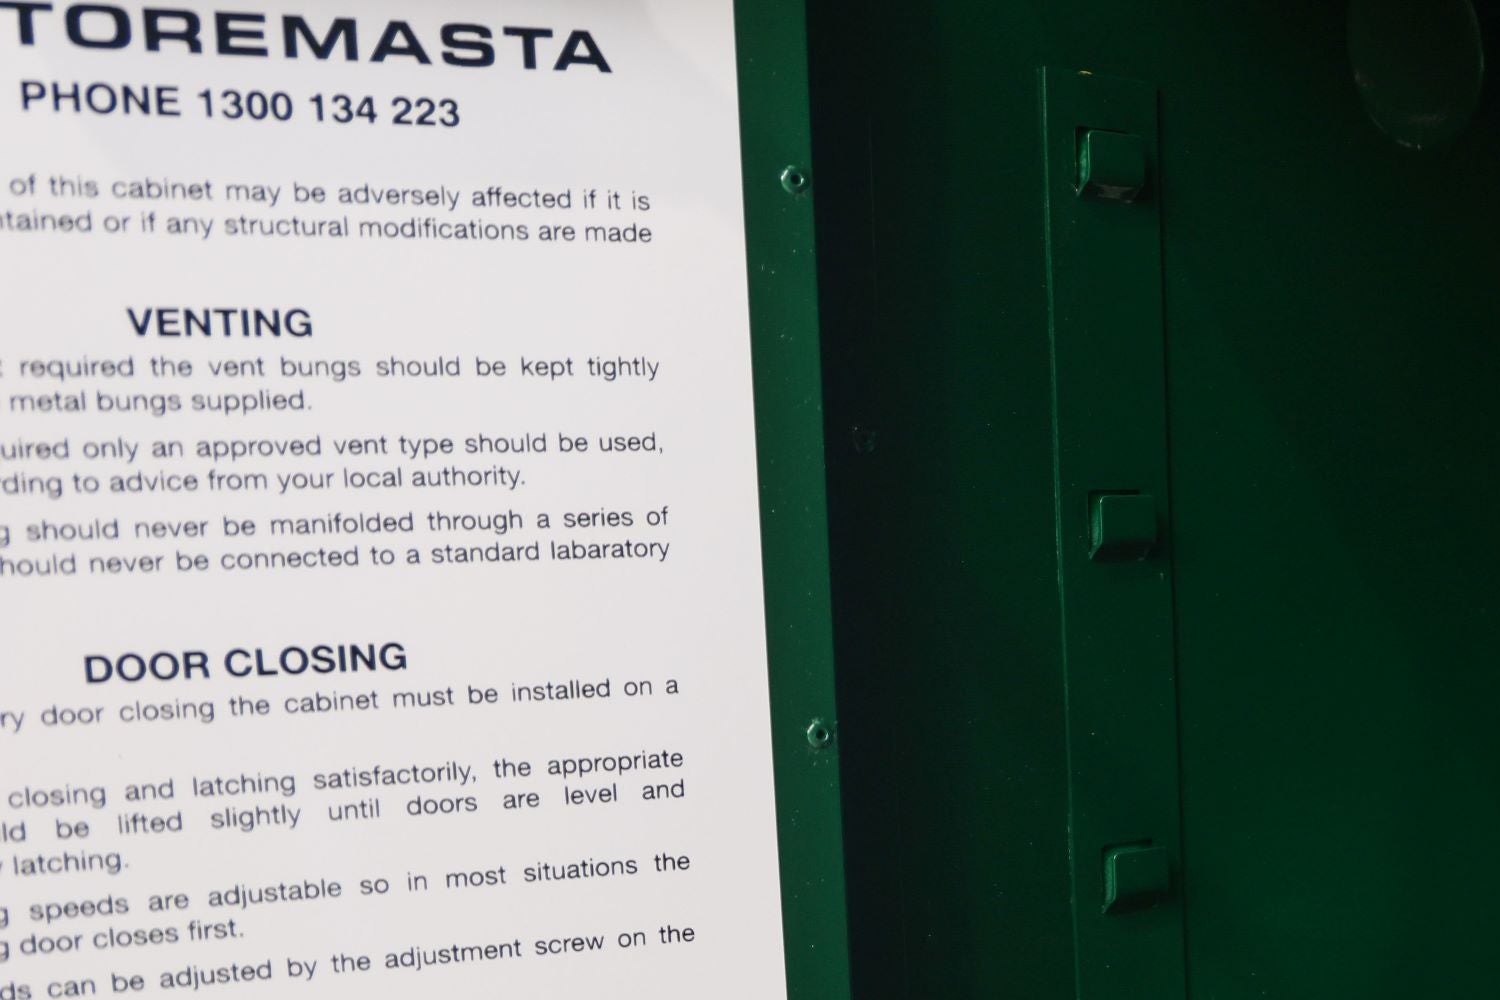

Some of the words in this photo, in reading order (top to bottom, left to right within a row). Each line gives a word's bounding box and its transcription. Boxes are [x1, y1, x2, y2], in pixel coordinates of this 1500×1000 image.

[0, 1, 612, 73] TOREMASTA
[20, 78, 181, 118] PHONE
[197, 87, 294, 123] 1300
[309, 92, 378, 125] 134
[391, 95, 460, 129] 223
[9, 172, 36, 196] of
[48, 175, 99, 199] this
[112, 177, 212, 201] cabinet
[226, 183, 280, 208] may
[293, 181, 326, 204] be
[338, 183, 460, 212] adversely
[472, 185, 571, 210] affected
[584, 188, 596, 209] if
[608, 189, 621, 211] it
[632, 190, 650, 212] is
[103, 215, 131, 234] or
[141, 211, 156, 233] if
[167, 216, 213, 241] any
[224, 214, 349, 238] structural
[359, 216, 529, 242] modifications
[539, 224, 576, 242] are
[585, 222, 652, 244] made
[125, 306, 312, 339] VENTING
[20, 355, 134, 383] required
[150, 355, 192, 378] the
[208, 356, 265, 378] vent
[280, 355, 361, 383] bungs
[376, 355, 460, 378] should
[476, 356, 506, 377] be
[521, 356, 574, 382] kept
[587, 355, 659, 383] tightly
[10, 390, 86, 413] metal
[96, 389, 182, 418] bungs
[191, 389, 312, 416] supplied.
[83, 437, 138, 464] only
[152, 440, 183, 459] an
[196, 434, 321, 463] approved
[333, 435, 388, 457] vent
[398, 434, 454, 460] type
[465, 431, 547, 455] should
[558, 431, 588, 453] be
[599, 431, 662, 454] used,
[0, 471, 63, 500] ding
[72, 473, 100, 494] to
[110, 470, 198, 493] advice
[207, 468, 267, 491] from
[277, 472, 334, 495] your
[343, 466, 402, 489] local
[412, 464, 525, 491] authority.
[26, 518, 119, 542] should
[135, 520, 208, 539] never
[223, 515, 256, 538] be
[270, 511, 414, 536] manifolded
[427, 508, 523, 536] through
[537, 512, 551, 529] a
[563, 506, 634, 529] series
[646, 505, 668, 527] of
[89, 555, 164, 574] never
[176, 550, 209, 572] be
[221, 545, 359, 571] connected
[369, 545, 395, 566] to
[406, 548, 421, 566] a
[431, 540, 539, 565] standard
[551, 538, 670, 563] labaratory
[84, 649, 210, 685] DOOR
[224, 641, 407, 679] CLOSING
[41, 704, 104, 727] door
[119, 698, 214, 725] closing
[228, 695, 270, 717] the
[284, 690, 379, 715] cabinet
[393, 686, 454, 709] must
[468, 684, 498, 705] be
[512, 677, 610, 703] installed
[624, 680, 652, 697] on
[666, 678, 679, 696] a
[8, 784, 106, 810] closing
[125, 777, 174, 802] and
[193, 771, 295, 798] latching
[313, 760, 476, 790] satisfactorily,
[492, 757, 531, 779] the
[548, 749, 683, 780] appropriate
[56, 818, 89, 840] be
[118, 810, 182, 835] lifted
[211, 803, 301, 833] slightly
[328, 797, 380, 822] until
[407, 794, 477, 817] doors
[503, 791, 540, 810] are
[565, 781, 617, 806] level
[642, 777, 684, 801] and
[13, 850, 128, 877] latching.
[29, 894, 129, 925] speeds
[149, 892, 189, 913] are
[208, 877, 342, 910] adjustable
[360, 877, 389, 896] so
[407, 871, 427, 892] in
[446, 865, 506, 889] most
[524, 857, 638, 883] situations
[653, 852, 690, 873] the
[20, 933, 83, 957] door
[93, 926, 179, 950] closes
[187, 918, 243, 942] first.
[47, 979, 96, 1000] can
[111, 972, 144, 994] be
[160, 959, 272, 992] adjusted
[287, 957, 317, 982] by
[330, 953, 371, 974] the
[385, 938, 522, 972] adjustment
[535, 935, 604, 956] screw
[618, 931, 646, 949] on
[658, 924, 695, 945] the
